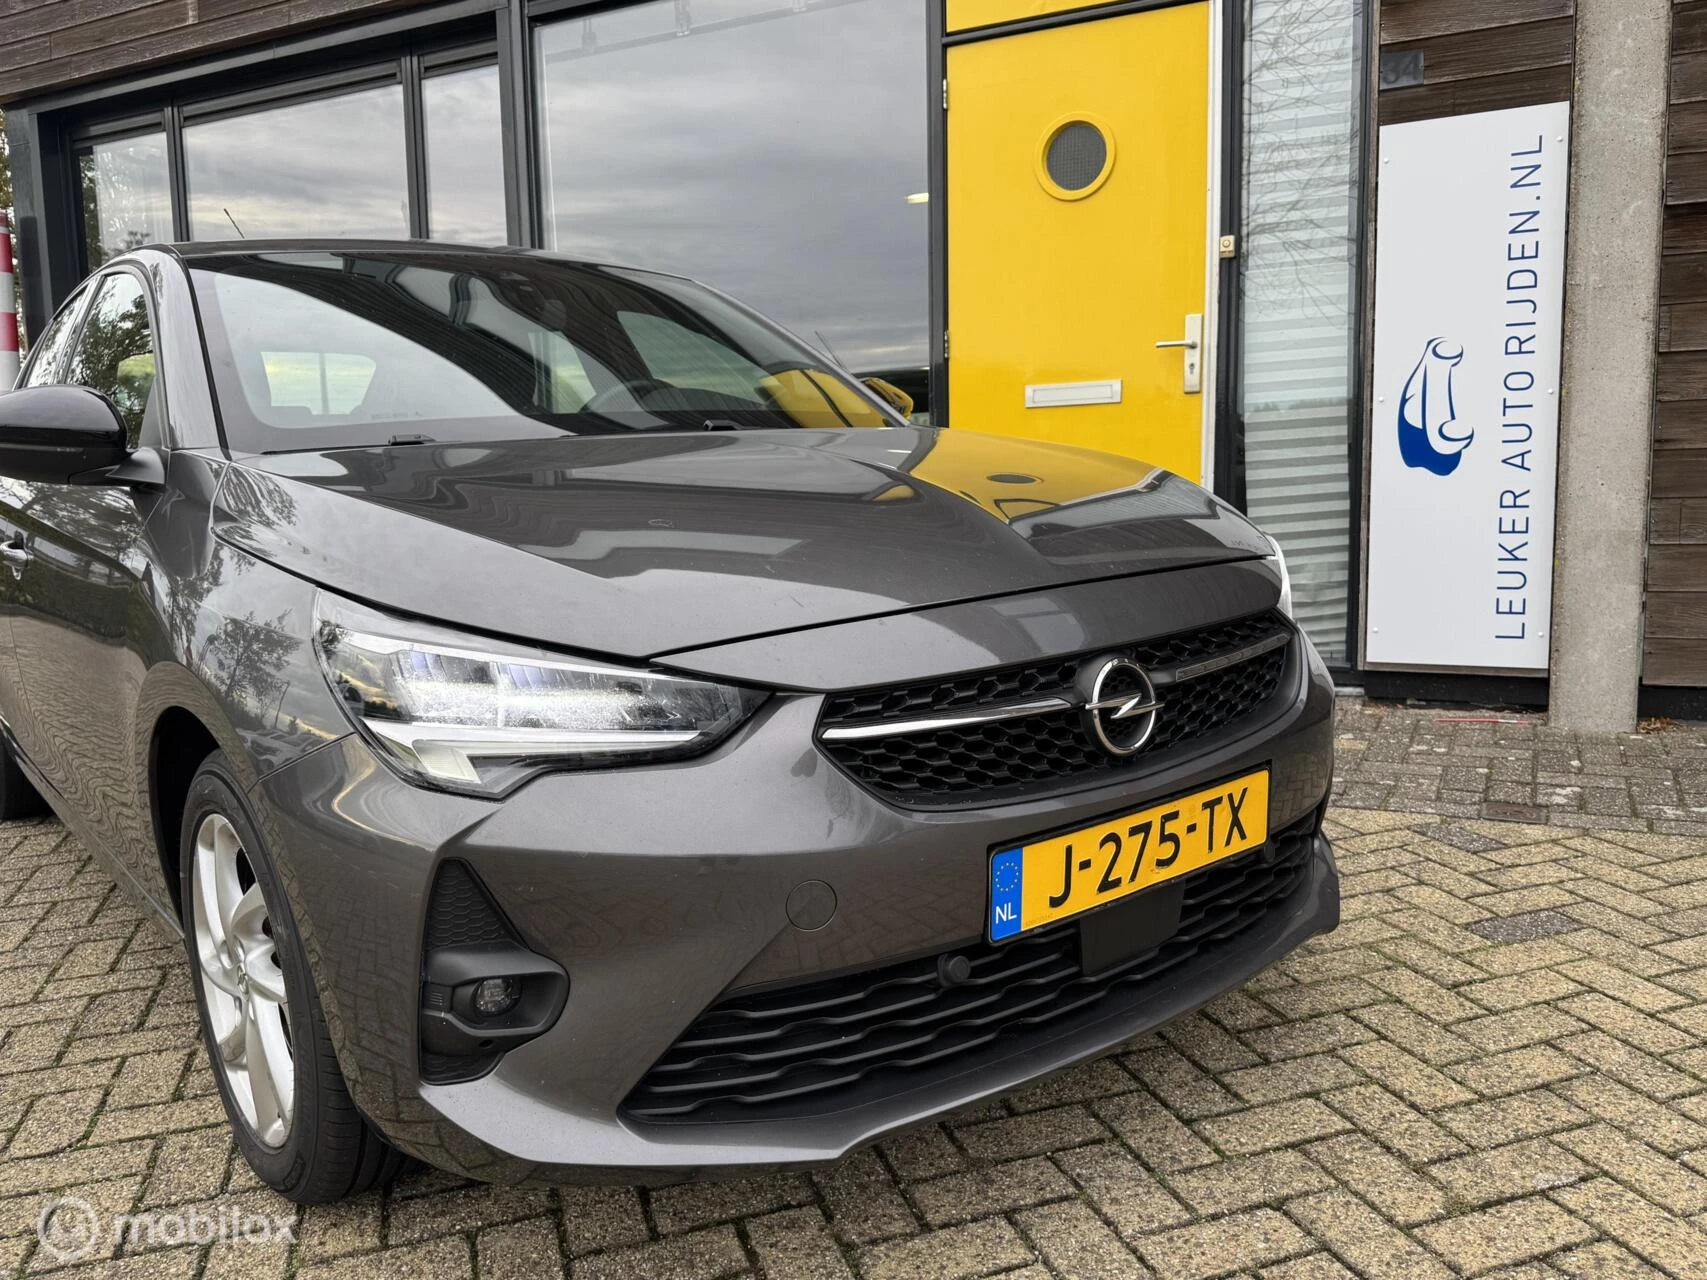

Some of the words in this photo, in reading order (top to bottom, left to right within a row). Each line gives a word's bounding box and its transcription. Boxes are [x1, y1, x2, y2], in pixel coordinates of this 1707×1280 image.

[1504, 134, 1543, 356] RIJDEN.NL
[1500, 370, 1535, 472] AUTO
[1494, 488, 1531, 639] LEUKER
[1048, 786, 1249, 909] J-275-TX
[995, 902, 1018, 925] NL
